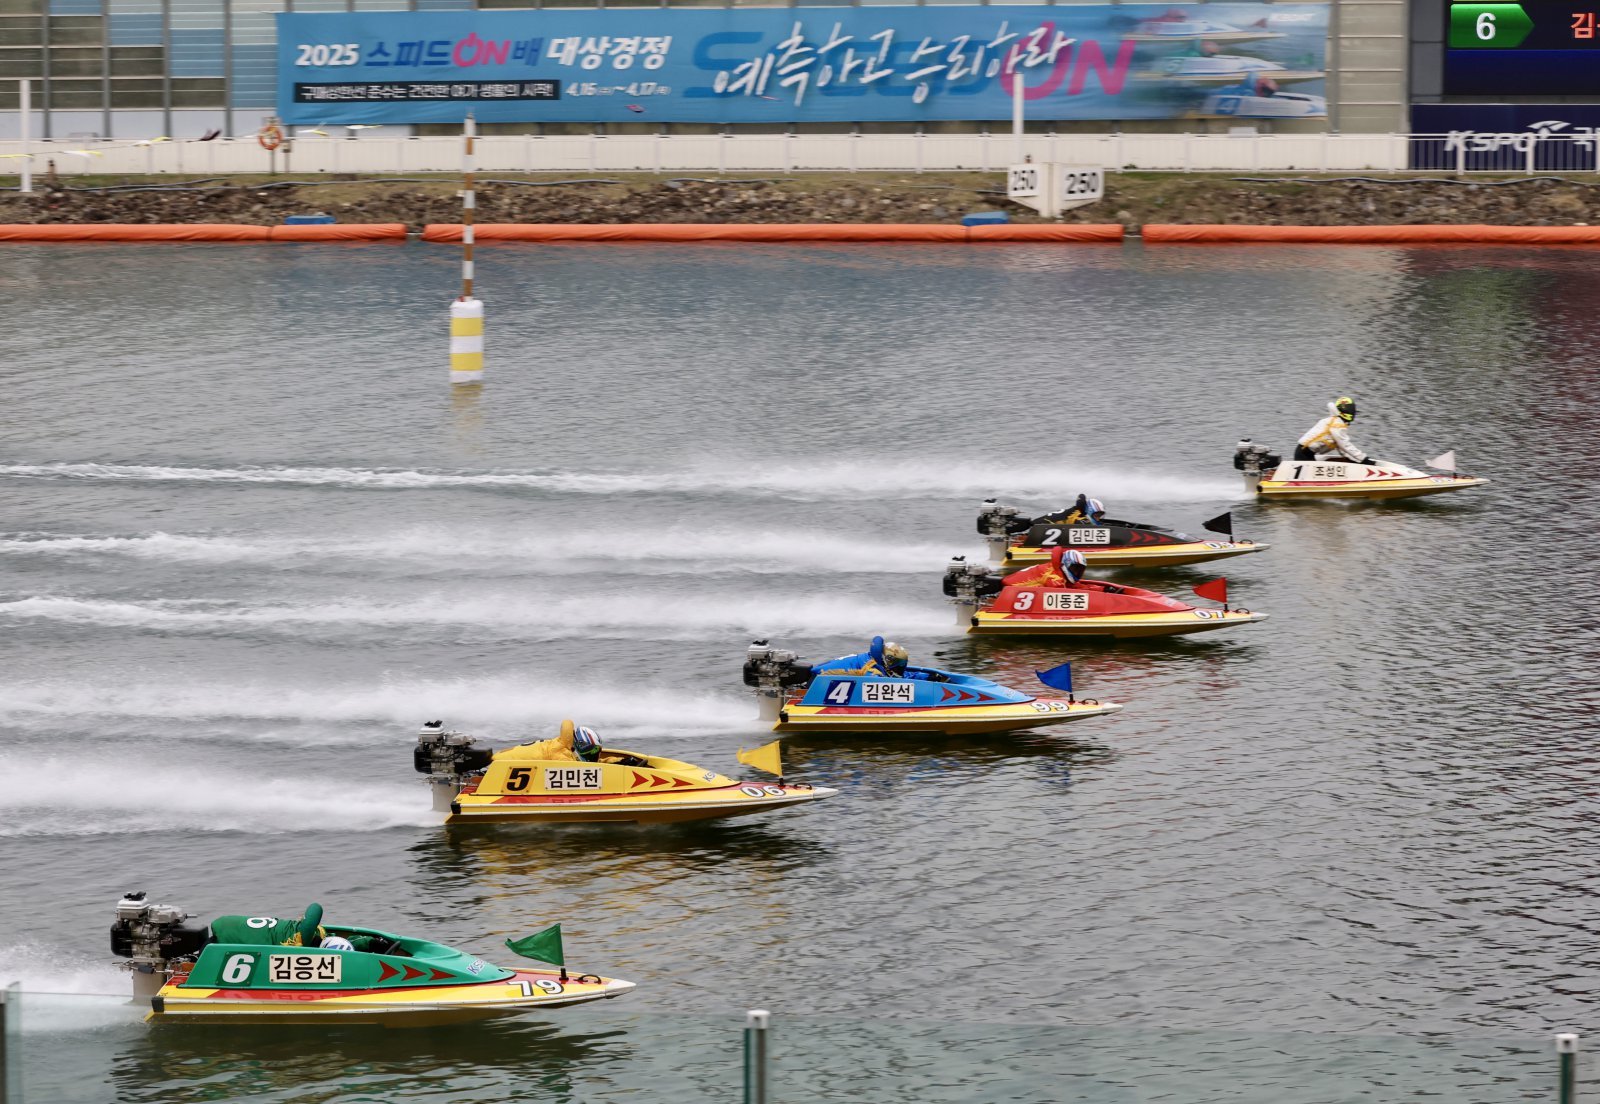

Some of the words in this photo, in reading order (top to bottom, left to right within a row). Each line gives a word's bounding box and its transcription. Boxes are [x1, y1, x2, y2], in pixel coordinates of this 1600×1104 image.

[1476, 12, 1496, 40] 6
[1571, 12, 1600, 39] 김
[295, 43, 359, 66] 2025
[546, 35, 673, 70] 대상경정
[713, 21, 895, 106] 예측하고
[904, 20, 1077, 104] 승리하라
[1011, 169, 1038, 191] 250
[1066, 172, 1100, 194] 250
[1292, 465, 1304, 480] 1
[1314, 465, 1347, 478] 조성인
[1041, 528, 1062, 546] 2
[1070, 529, 1109, 543] 김민준
[1014, 591, 1035, 610] 3
[1046, 592, 1086, 609] 이동준
[827, 681, 851, 704] 4
[866, 683, 912, 702] 김완석
[1030, 700, 1071, 713] 99
[506, 767, 532, 792] 5
[549, 769, 599, 788] 김민천
[740, 784, 787, 798] 06
[222, 953, 255, 983] 6
[274, 956, 337, 982] 김응선
[506, 979, 565, 997] 79
